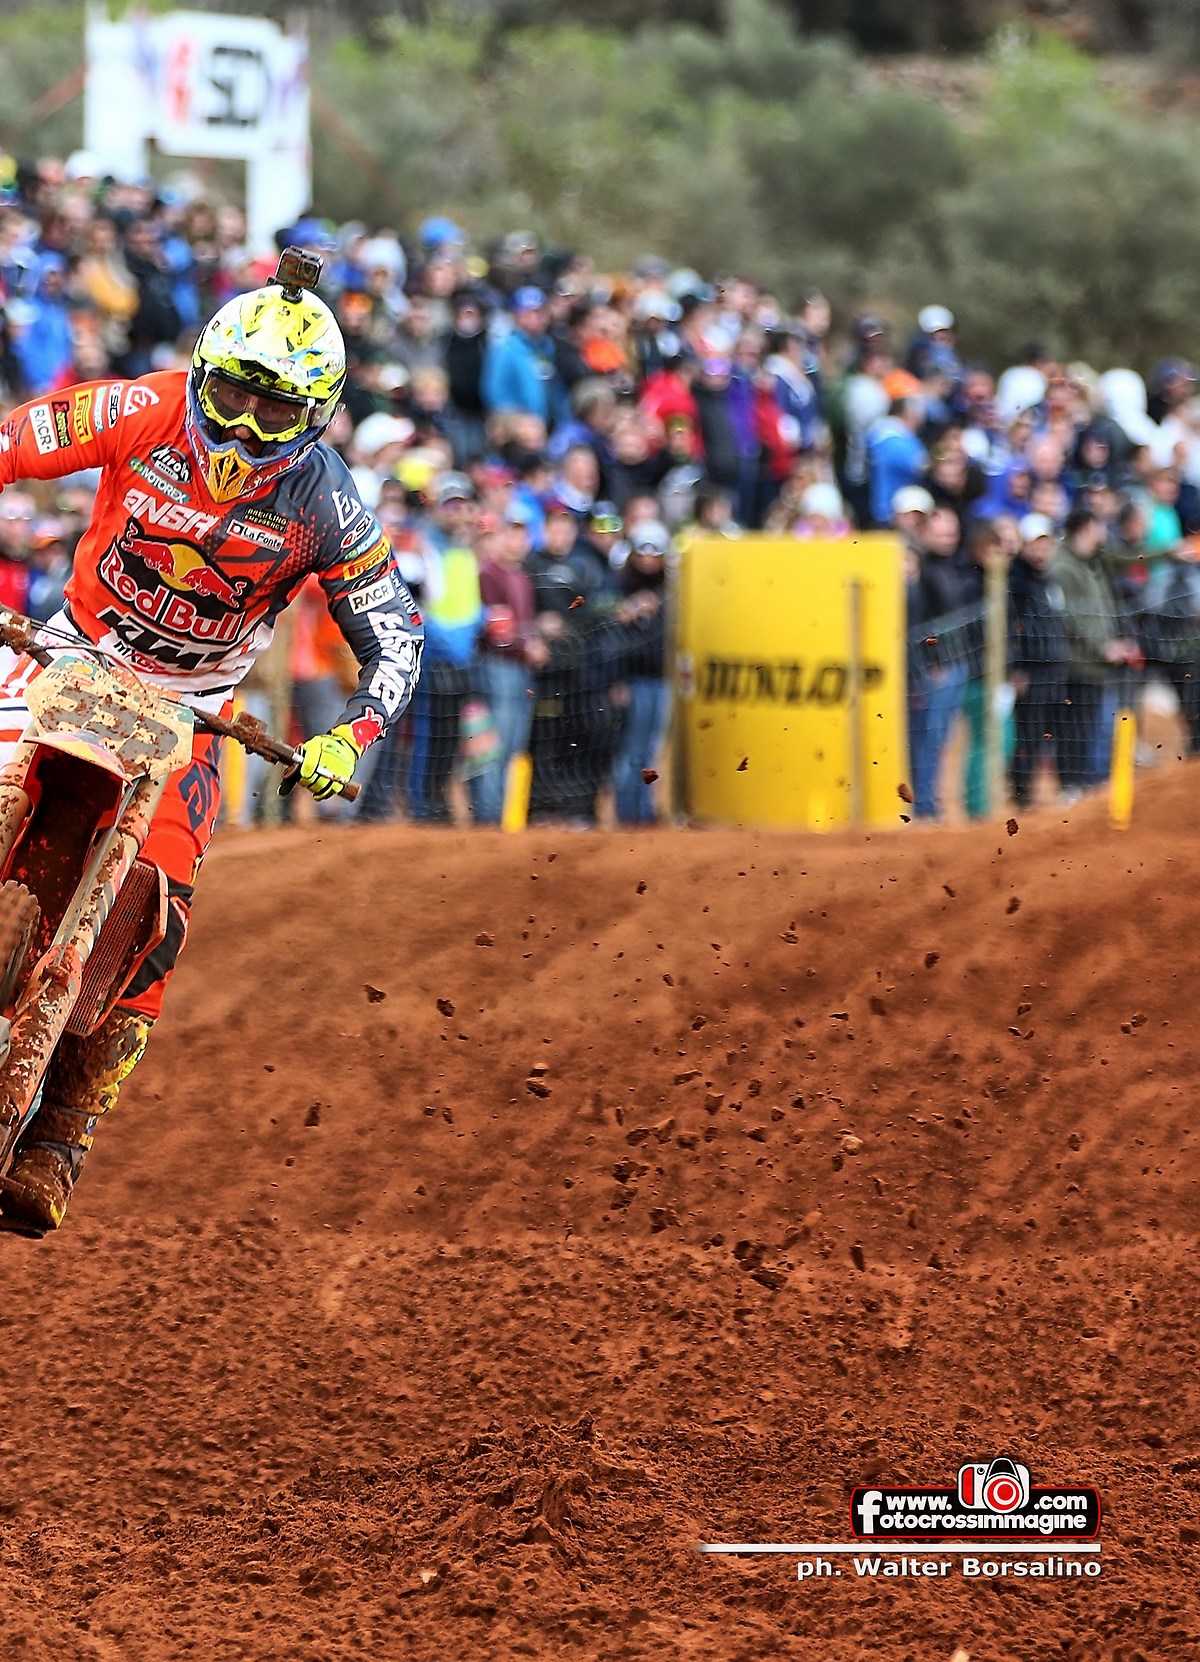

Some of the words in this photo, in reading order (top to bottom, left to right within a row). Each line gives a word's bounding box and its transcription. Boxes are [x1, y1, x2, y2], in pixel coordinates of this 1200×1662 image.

[141, 466, 189, 504] MOTOREX
[243, 526, 255, 540] La
[255, 529, 283, 548] Fonte
[100, 542, 169, 621] Red
[160, 594, 246, 642] Bull
[96, 605, 231, 672] KTM
